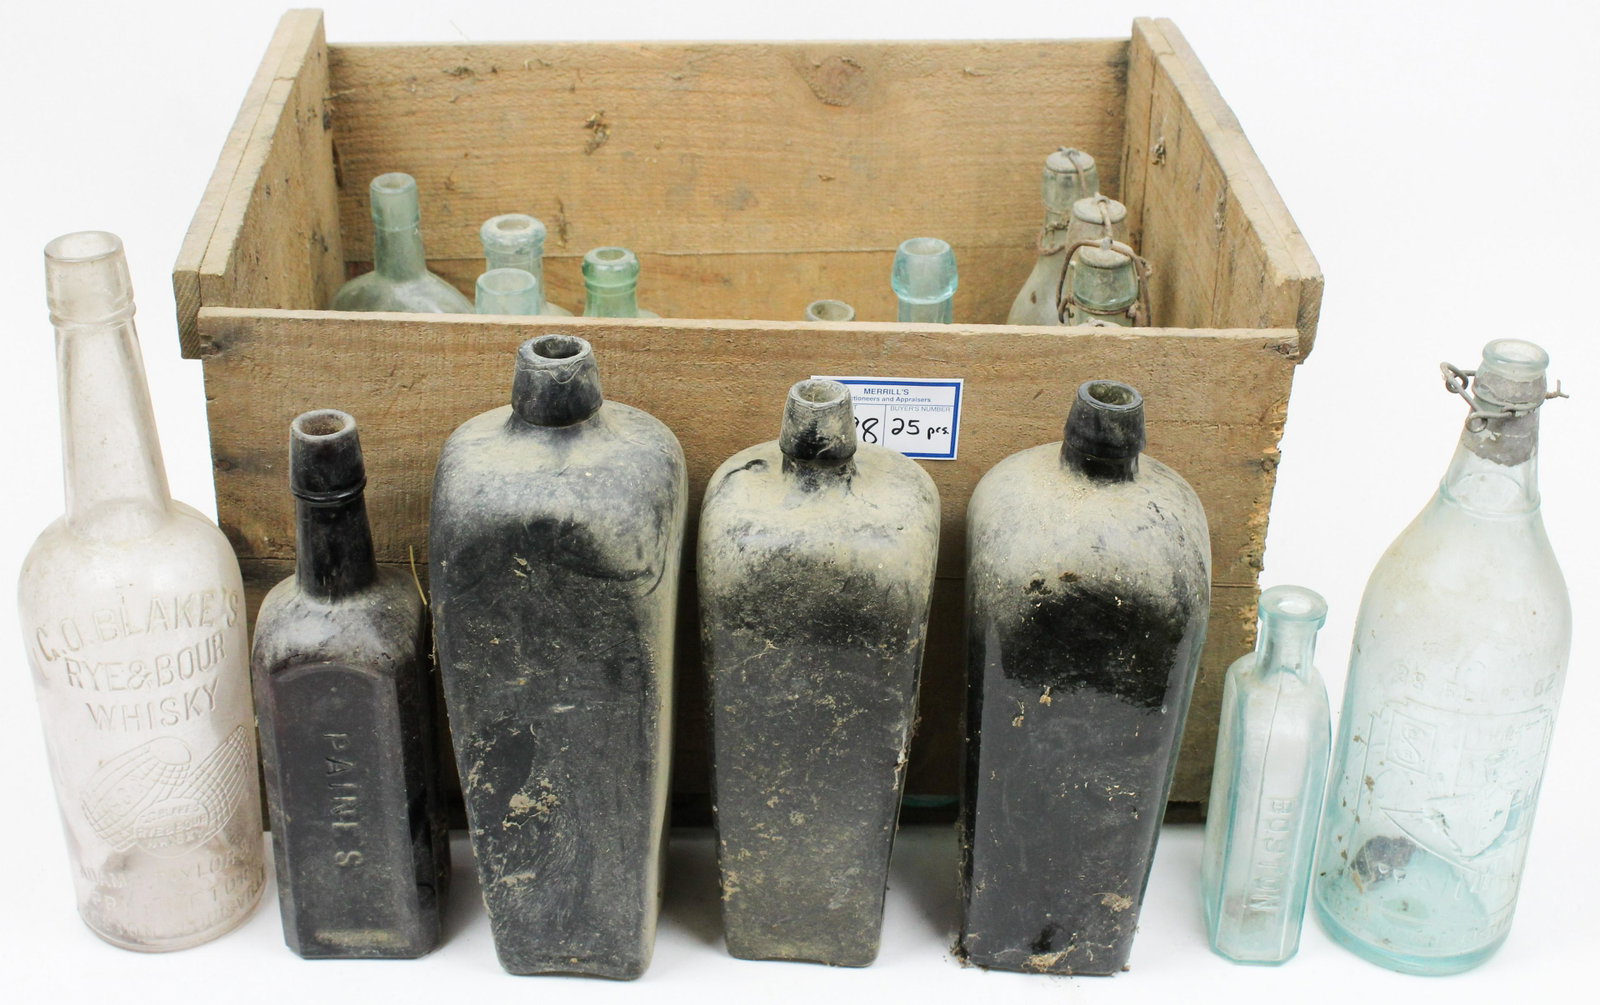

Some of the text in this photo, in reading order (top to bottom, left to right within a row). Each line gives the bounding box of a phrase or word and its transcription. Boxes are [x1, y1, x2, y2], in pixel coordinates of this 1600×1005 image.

[863, 388, 910, 396] MERRILL'S
[896, 396, 931, 404] Appraisers
[891, 418, 920, 435] 25
[85, 676, 220, 732] WHISKY
